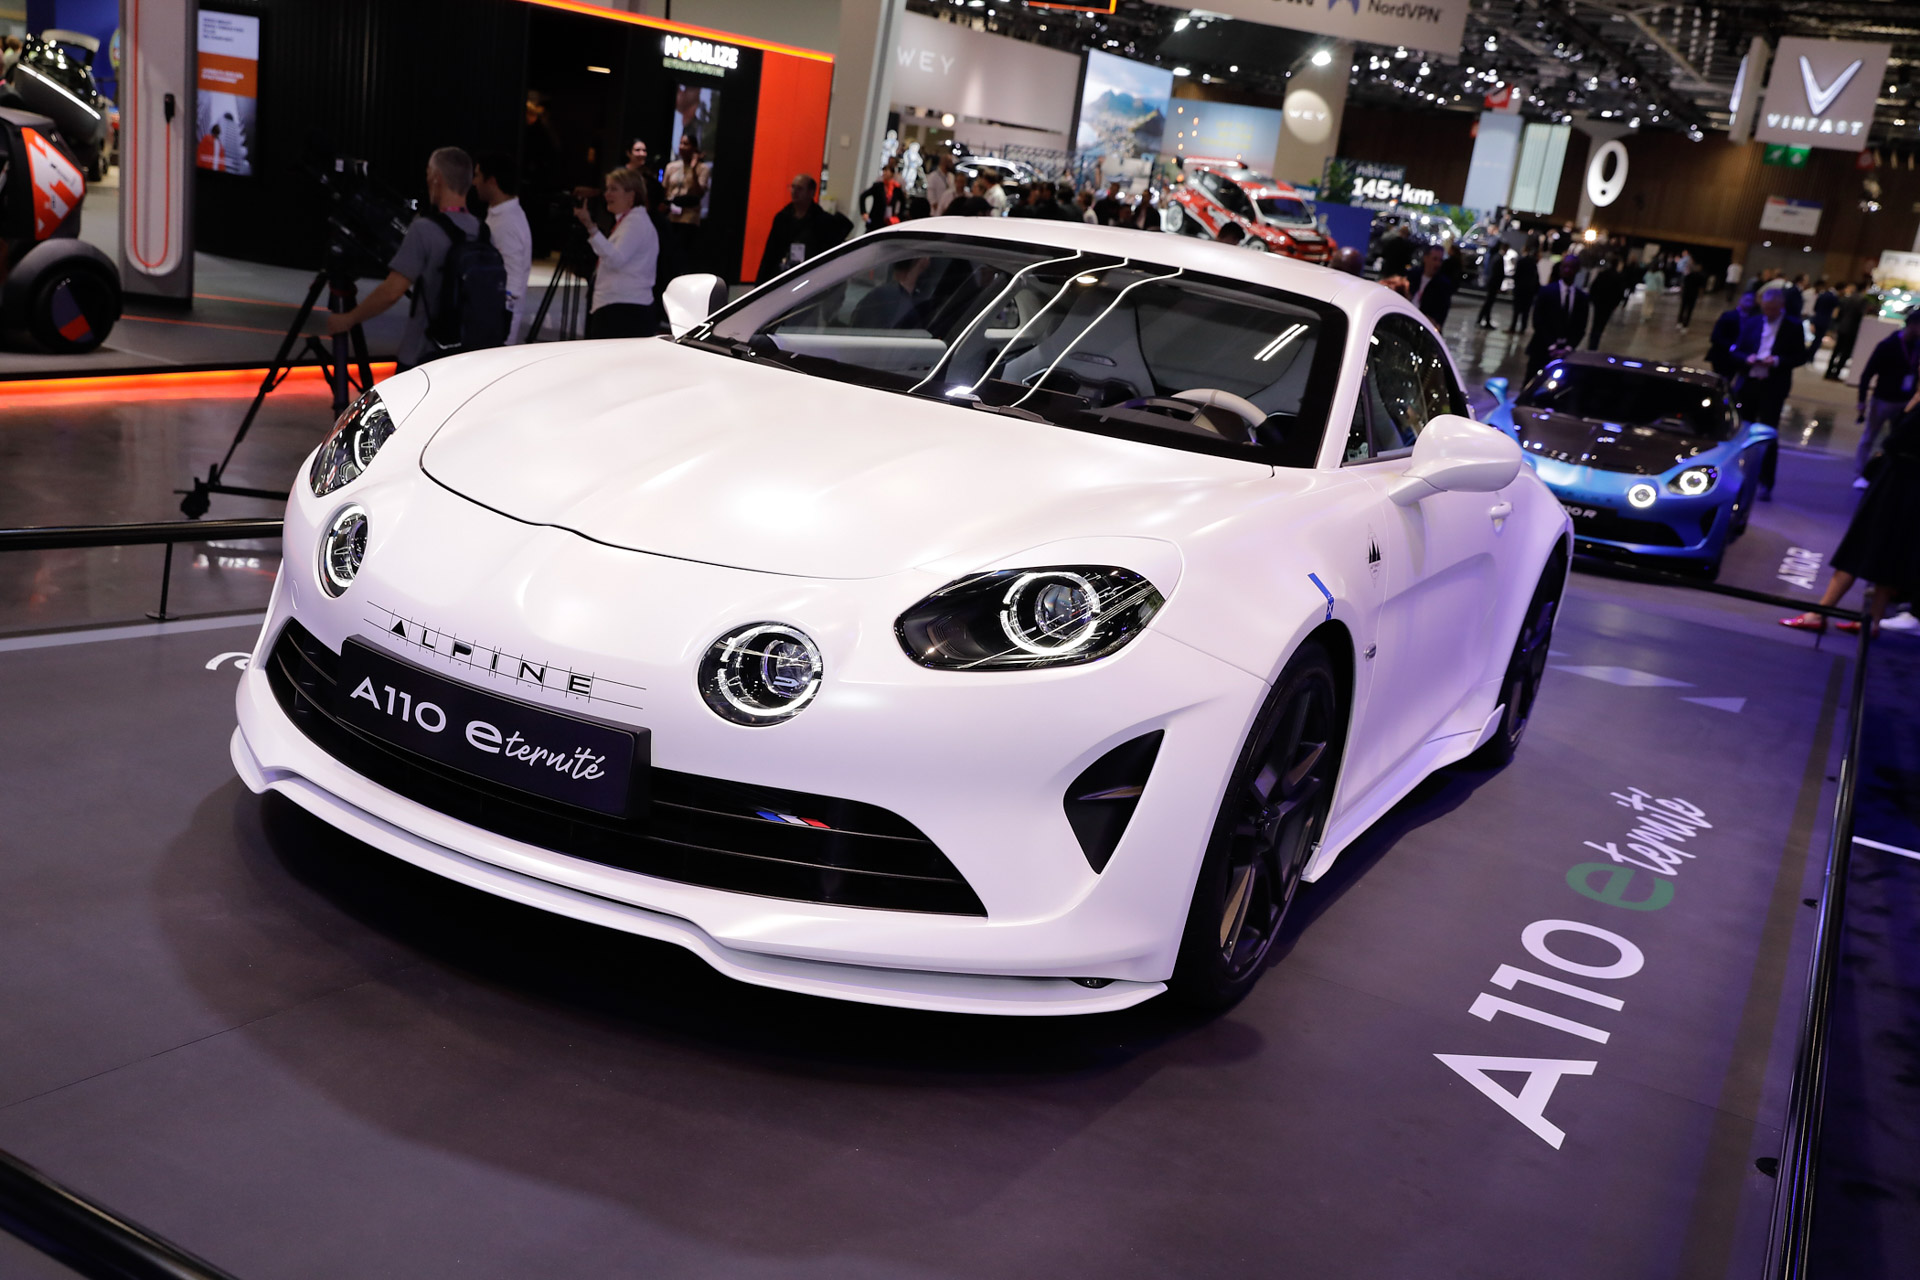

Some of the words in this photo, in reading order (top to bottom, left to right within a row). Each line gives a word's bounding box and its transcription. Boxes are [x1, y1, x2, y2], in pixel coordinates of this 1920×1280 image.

[1368, 0, 1441, 24] NordVPN
[664, 34, 739, 70] MOBILIZE
[897, 45, 956, 76] WEY
[1287, 108, 1329, 121] WEY
[1767, 113, 1863, 136] VINFAST
[391, 620, 592, 695] ALPINE
[350, 676, 447, 733] A110
[465, 720, 605, 780] eternité
[1432, 918, 1645, 1151] A110
[1565, 786, 1713, 911] eternité
